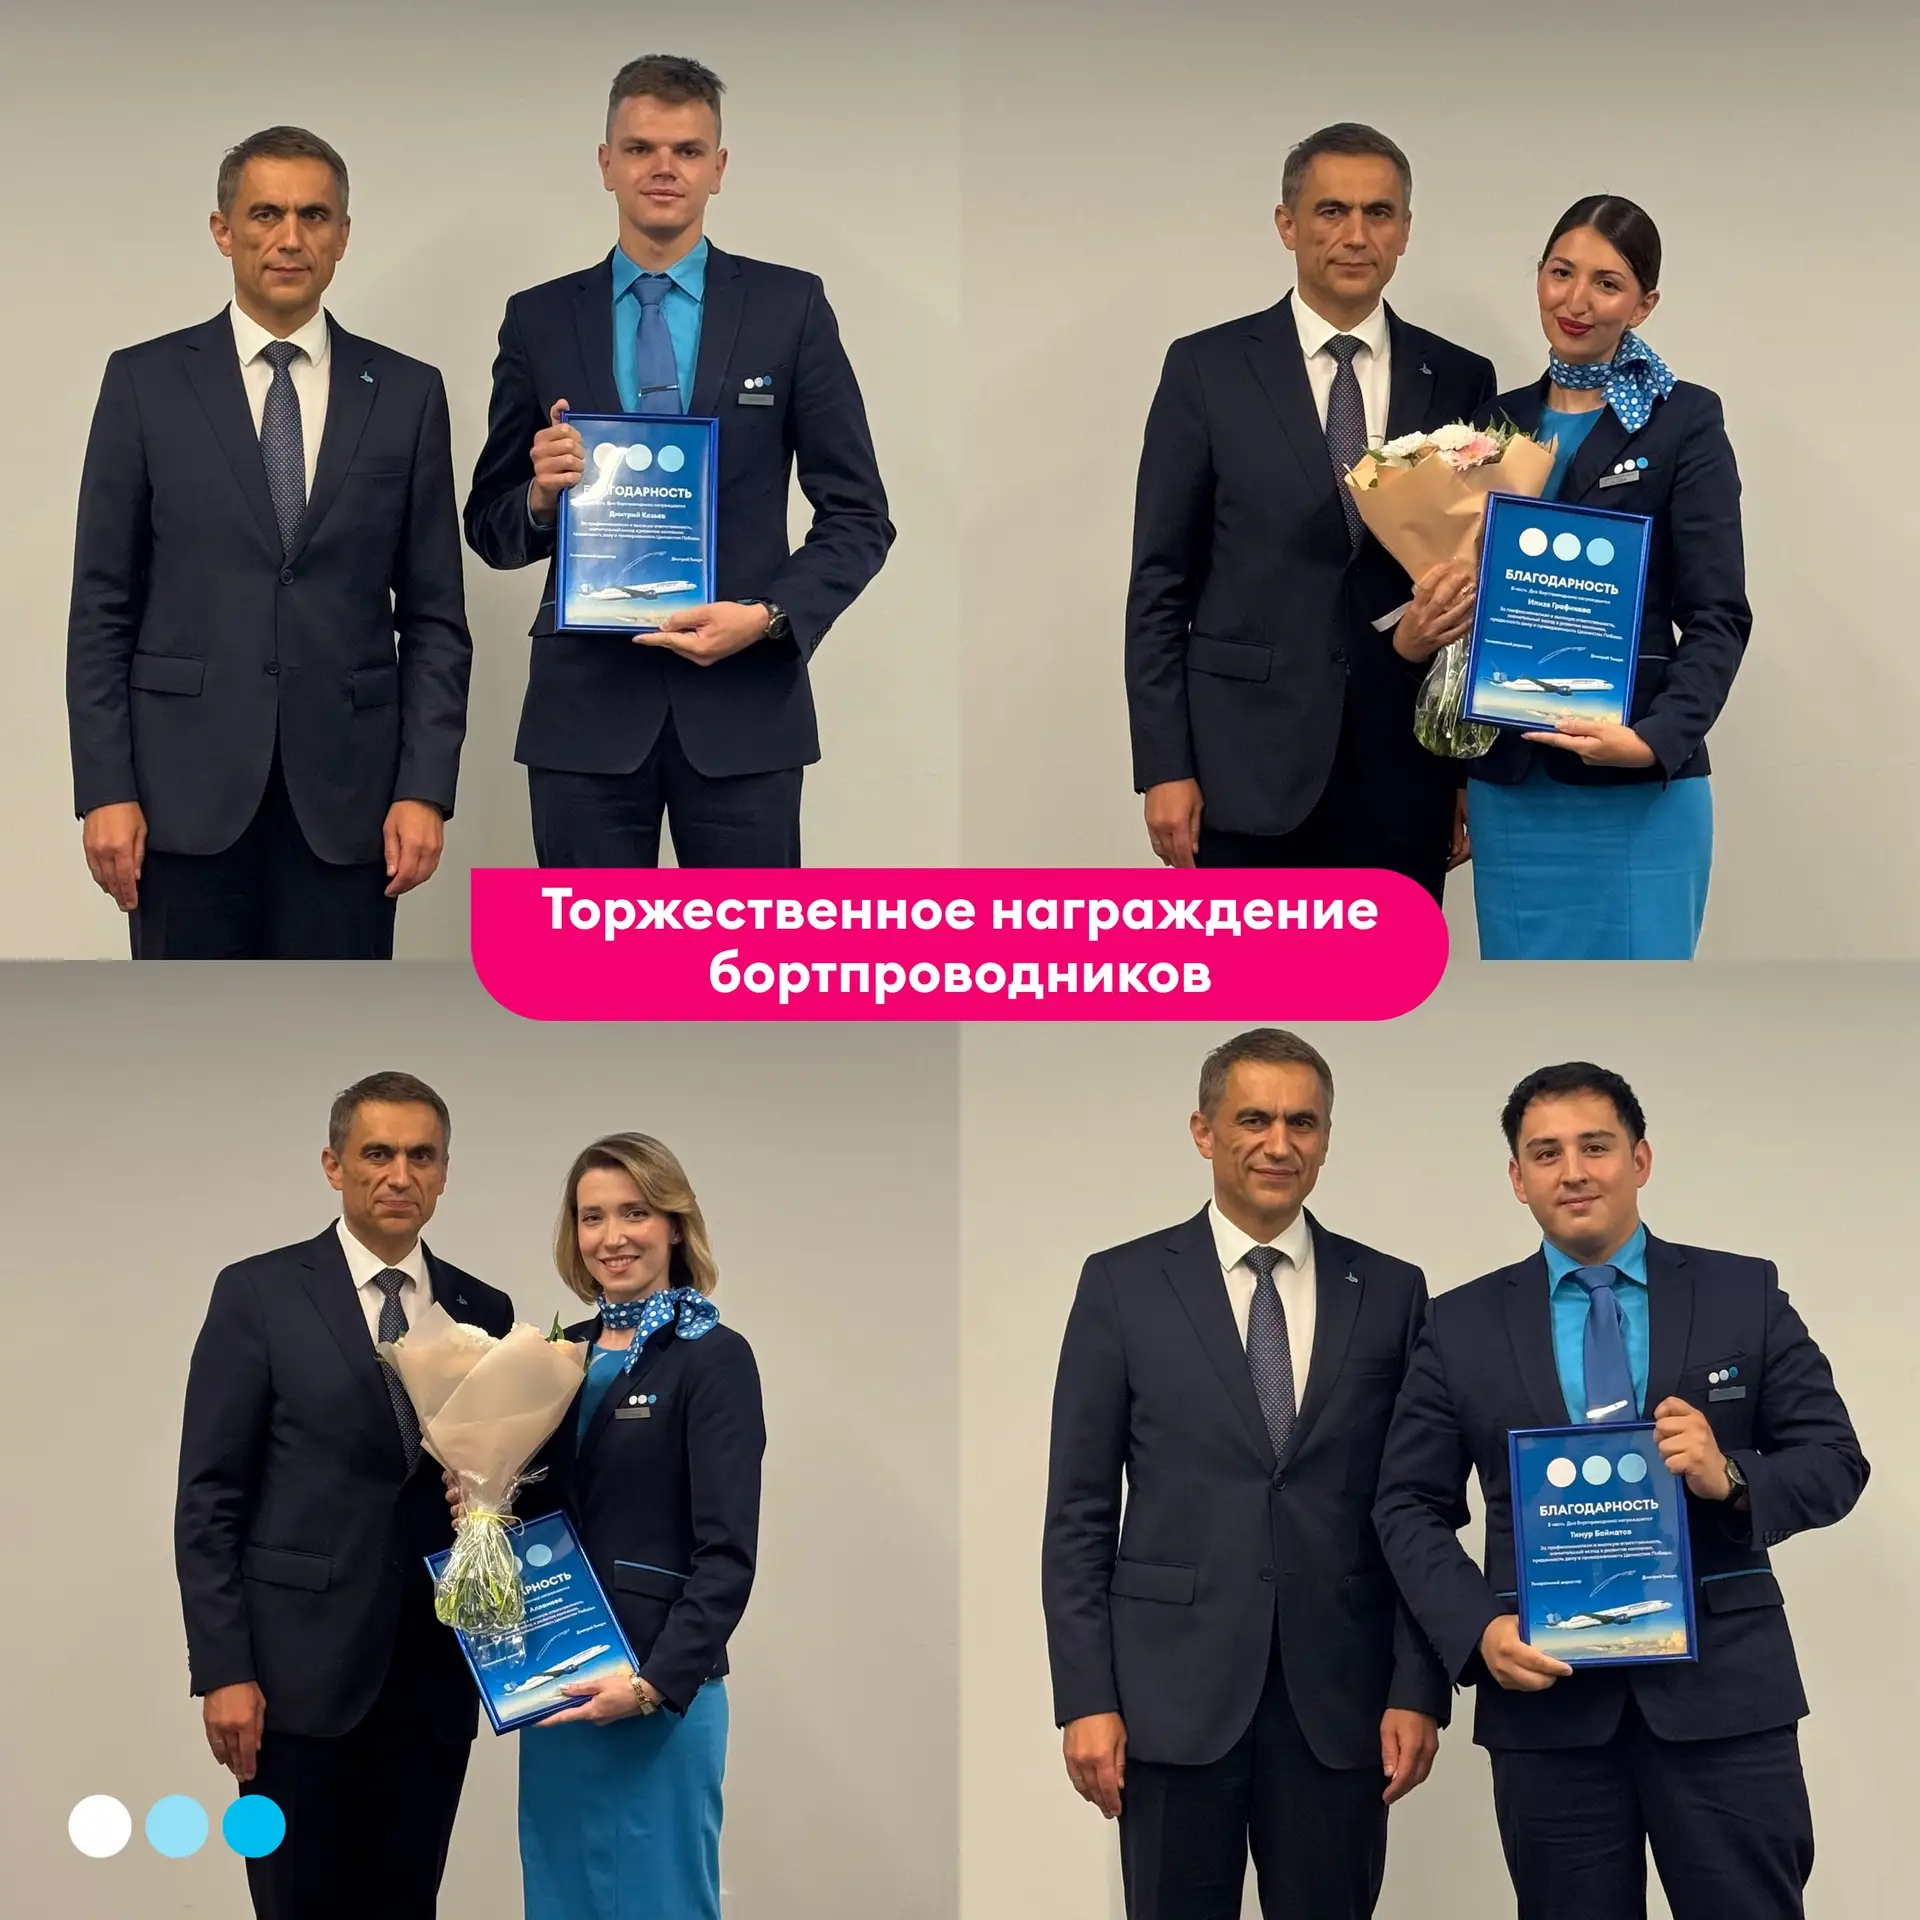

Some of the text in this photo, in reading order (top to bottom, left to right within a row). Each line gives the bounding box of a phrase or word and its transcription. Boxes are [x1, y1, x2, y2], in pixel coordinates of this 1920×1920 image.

[1505, 568, 1619, 595] БЛАГОДАРНОСТЬ
[1540, 1499, 1659, 1517] БЛАГОДАРНОСТЬ
[1570, 1530, 1594, 1540] Тимур
